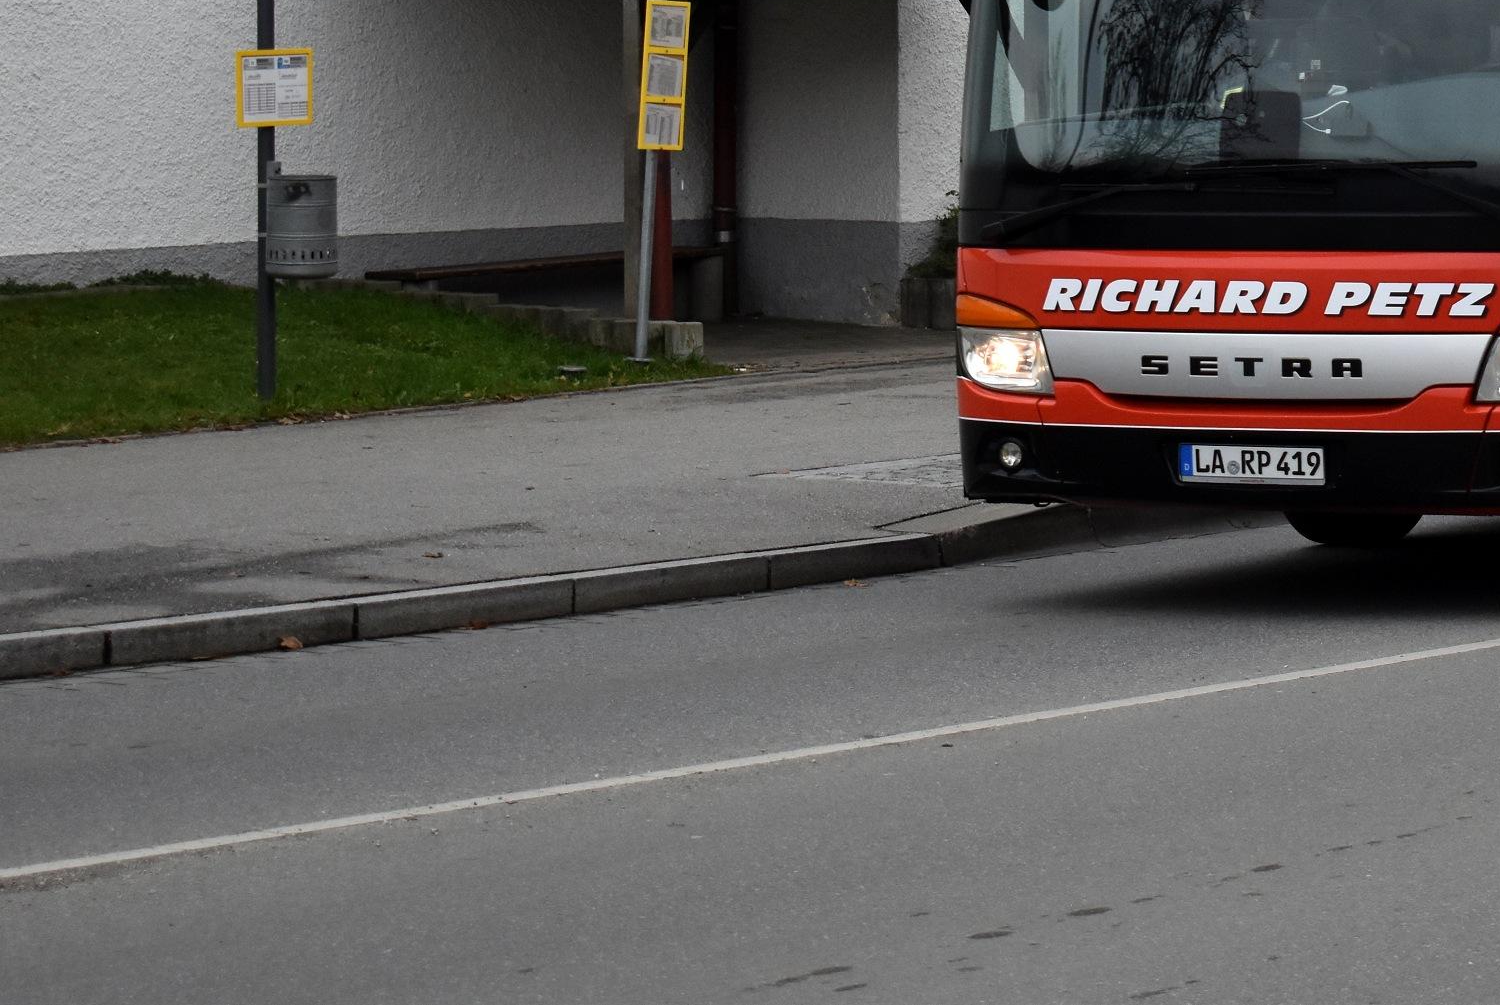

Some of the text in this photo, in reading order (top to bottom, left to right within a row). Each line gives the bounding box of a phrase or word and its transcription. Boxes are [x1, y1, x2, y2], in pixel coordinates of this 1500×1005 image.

[1042, 278, 1496, 317] RICHARD PETZ
[1141, 354, 1363, 378] SETRA
[1195, 449, 1225, 474] LA
[1241, 450, 1271, 474] RP
[1276, 451, 1321, 476] 419
